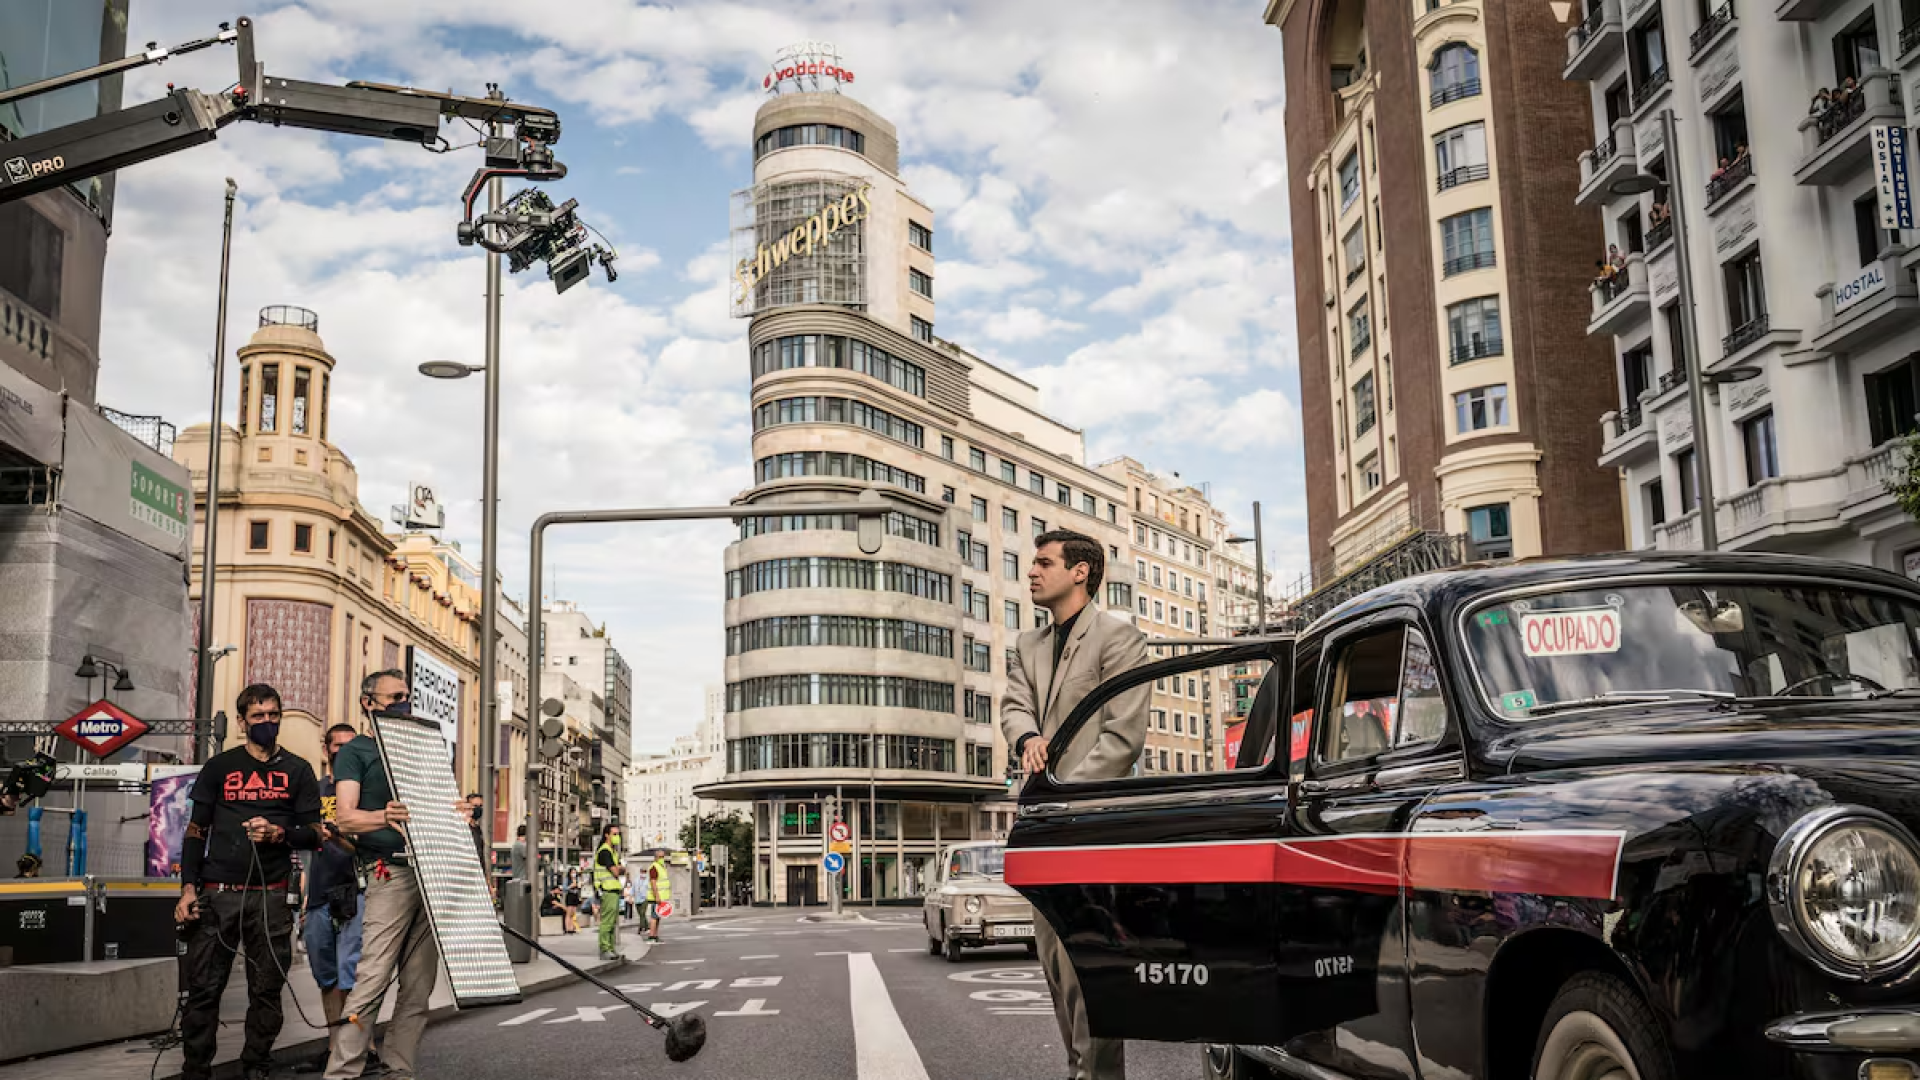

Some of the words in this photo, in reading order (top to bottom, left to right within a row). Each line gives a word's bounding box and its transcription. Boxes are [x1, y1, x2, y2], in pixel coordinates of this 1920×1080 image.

[775, 60, 855, 84] vodafone
[32, 156, 65, 176] PRO
[1876, 129, 1891, 195] HOSTAL
[1890, 127, 1910, 228] CONTINENTAL
[735, 183, 873, 305] Schweppes
[1835, 268, 1883, 305] HOSTAL
[1526, 613, 1617, 654] OCUPADO
[414, 662, 457, 703] FABRICADO
[413, 687, 426, 712] EN
[426, 691, 456, 724] MADRID
[80, 721, 120, 734] Metro
[83, 766, 118, 777] Callao
[223, 770, 290, 792] BAD
[224, 788, 237, 801] to
[237, 788, 258, 801] the
[597, 975, 784, 994] BUS
[1134, 962, 1210, 986] 15170
[497, 998, 782, 1026] TAXI
